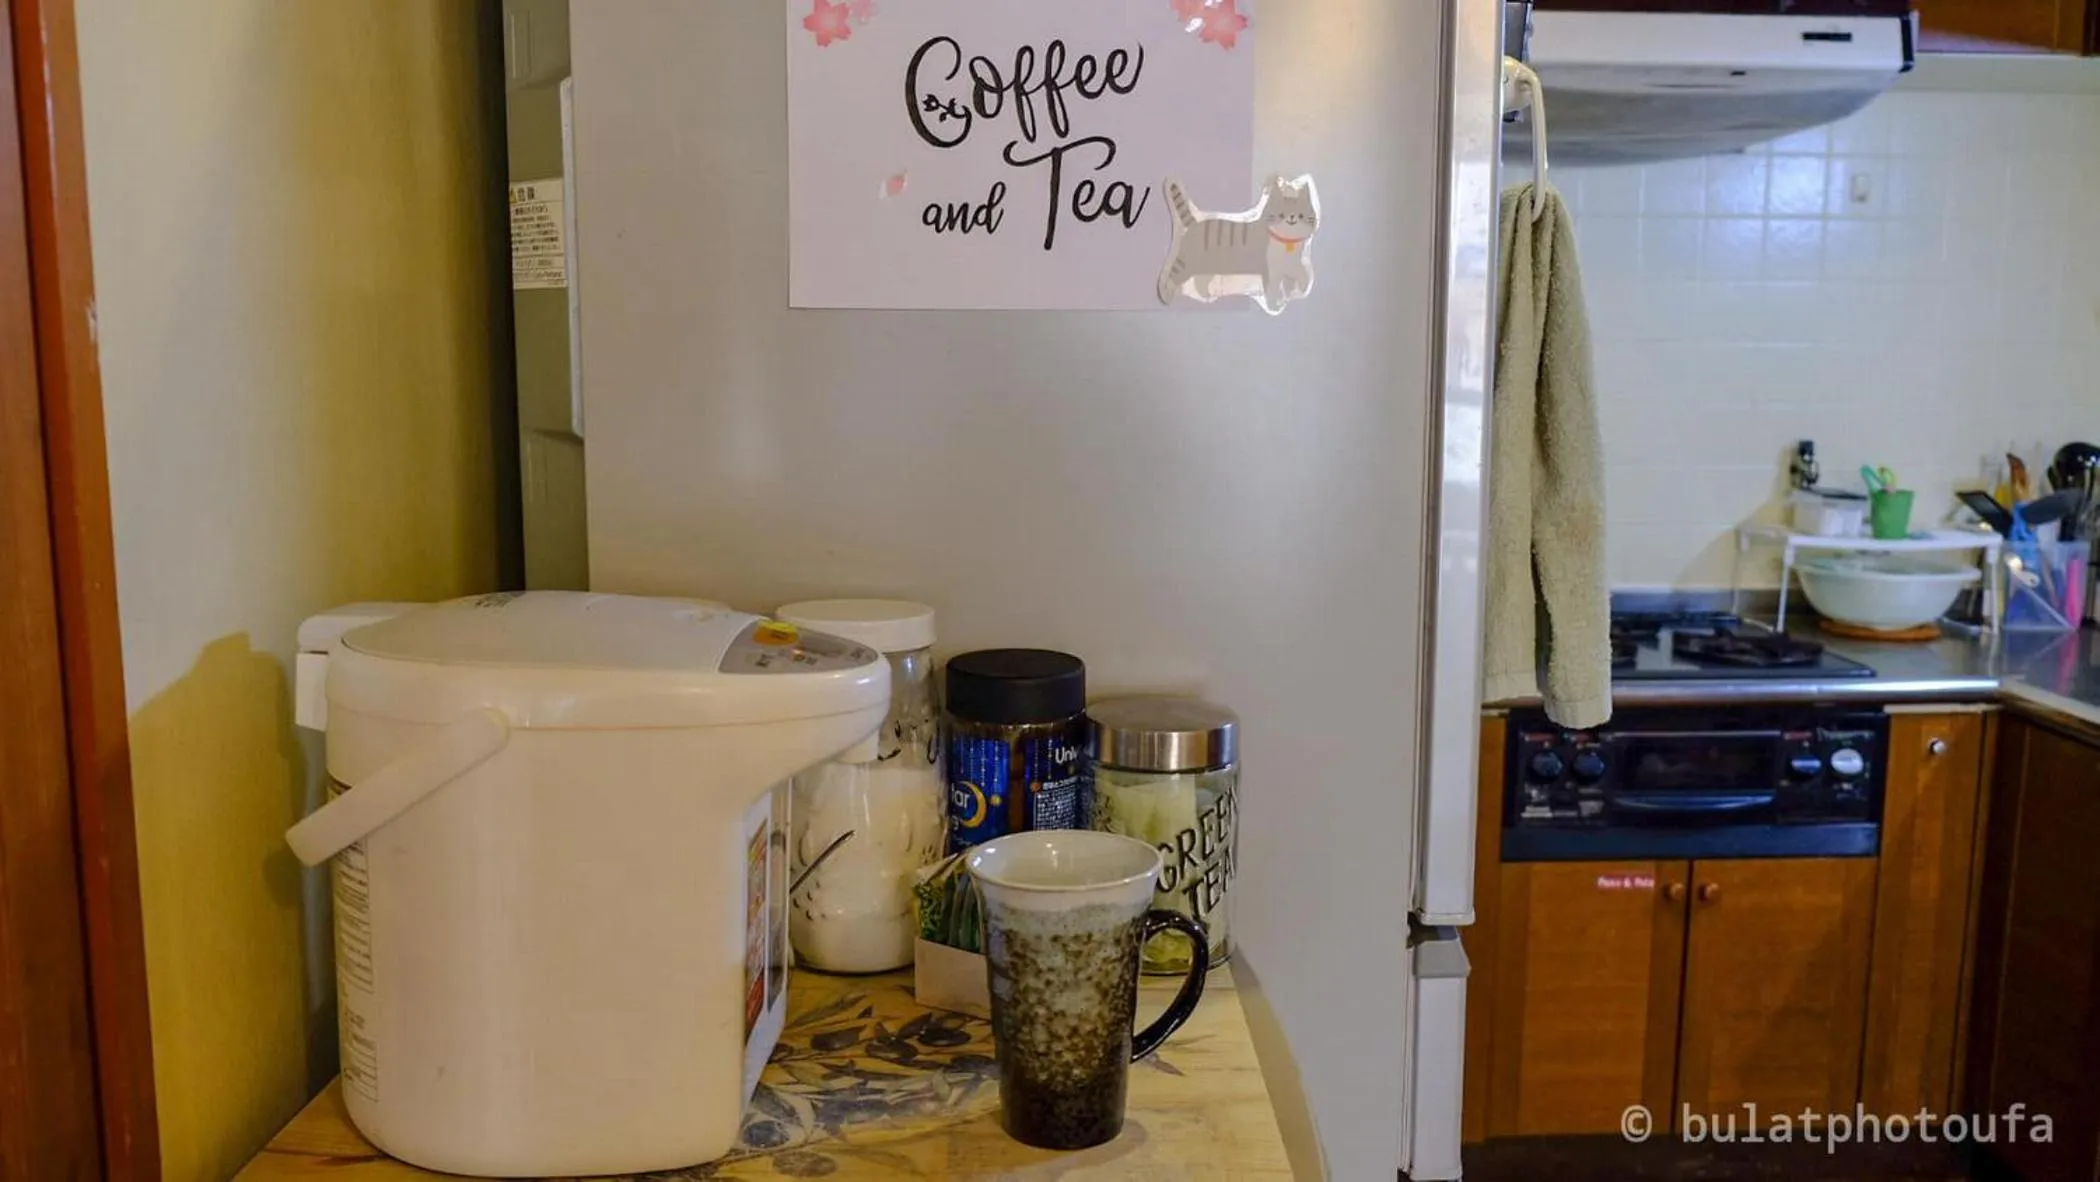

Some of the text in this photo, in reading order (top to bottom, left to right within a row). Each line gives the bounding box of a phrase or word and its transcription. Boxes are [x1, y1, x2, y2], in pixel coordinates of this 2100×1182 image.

[905, 36, 1144, 148] Coffee
[922, 136, 1151, 250] and Tea
[1181, 846, 1234, 921] TEA
